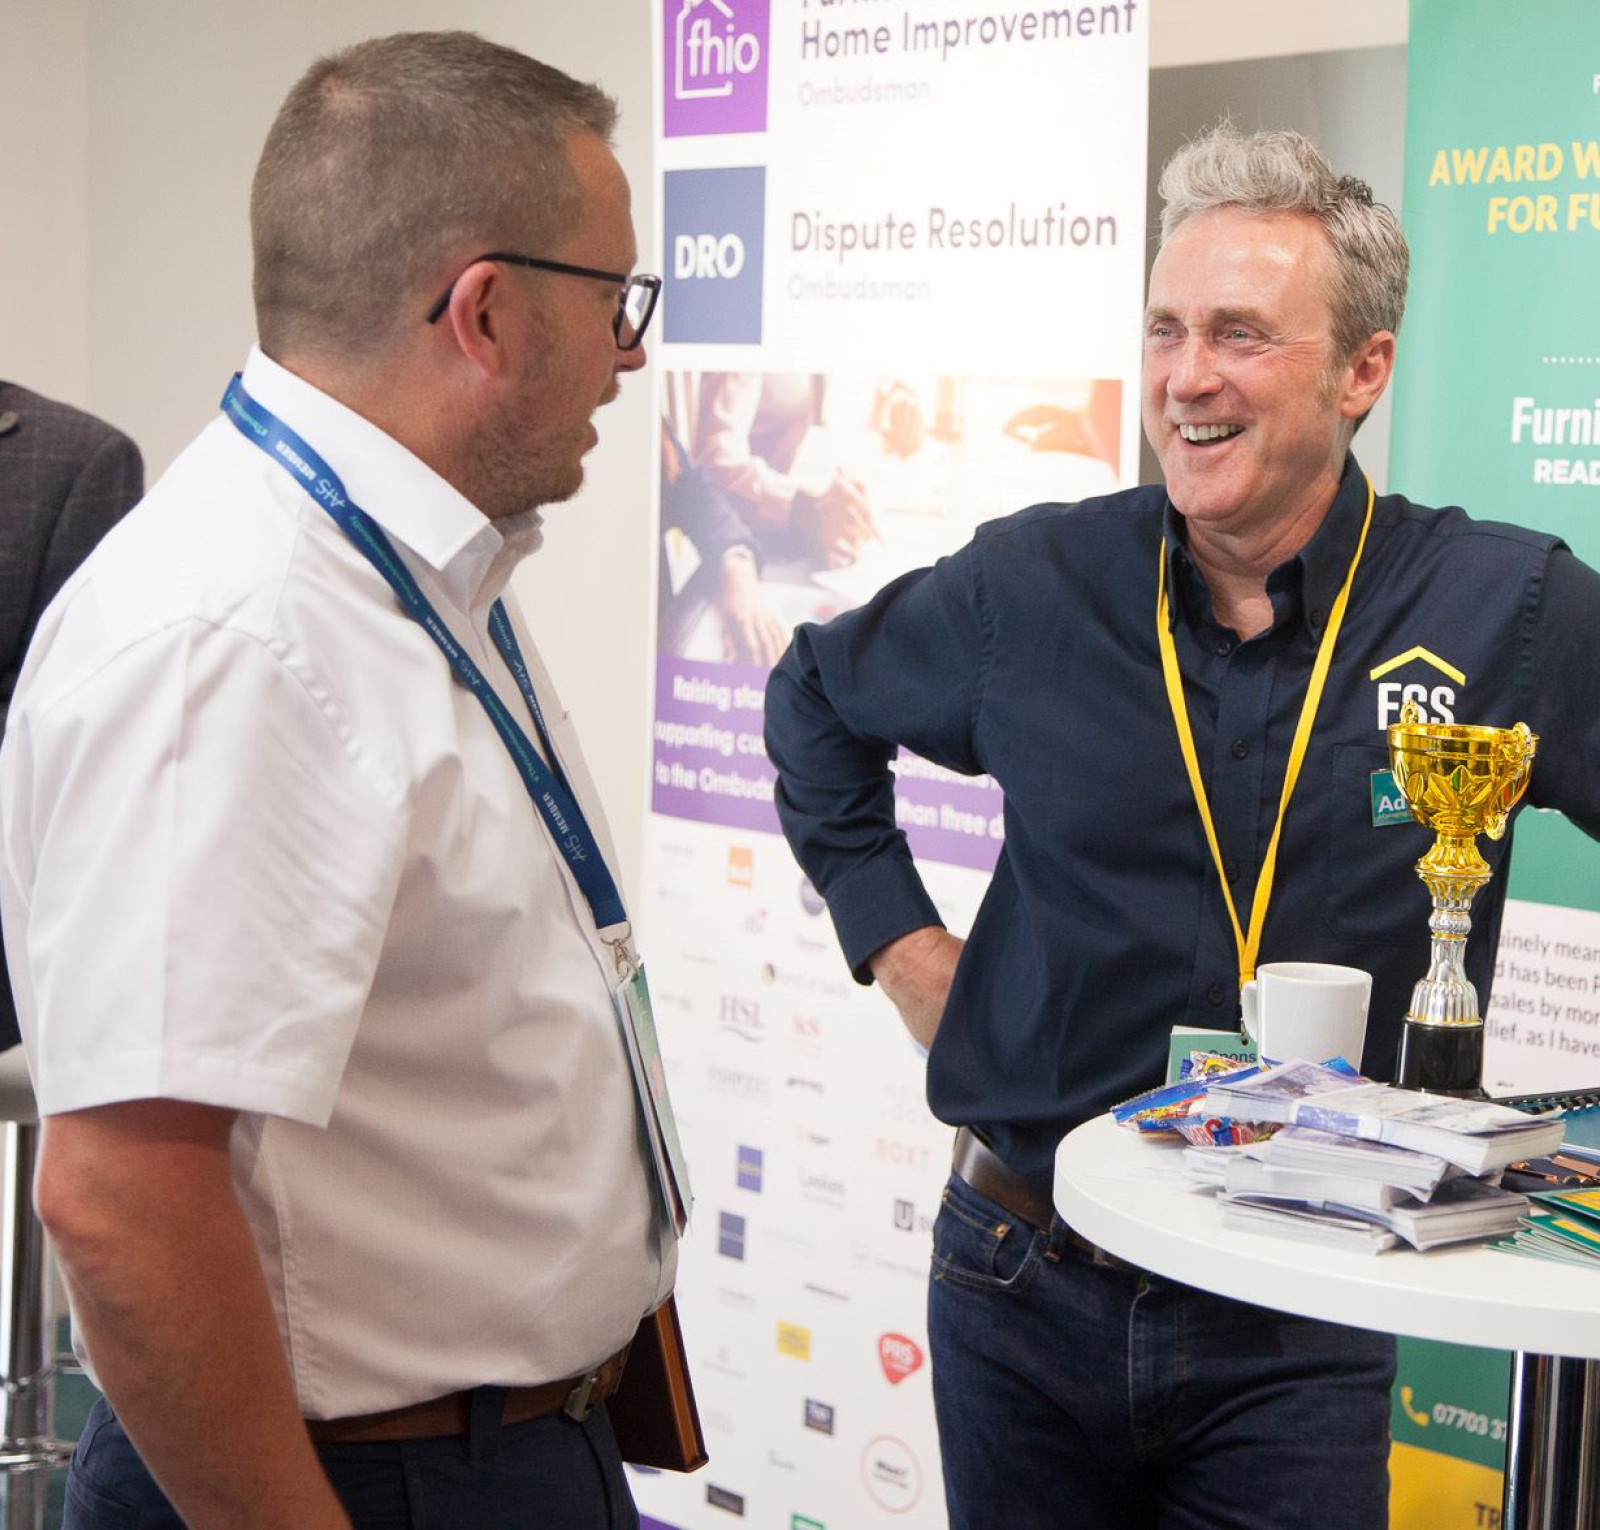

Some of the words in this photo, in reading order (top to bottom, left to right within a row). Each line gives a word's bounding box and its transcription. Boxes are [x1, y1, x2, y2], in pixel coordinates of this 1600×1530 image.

[686, 17, 760, 77] fhio
[801, 19, 891, 59] Home
[903, 0, 1137, 61] Improvement
[797, 78, 931, 105] Ombudsman
[1428, 142, 1563, 188] AWARD
[791, 211, 917, 264] Dispute
[928, 202, 1117, 249] Resolution
[1486, 194, 1558, 235] FOR
[673, 233, 745, 280] DRO
[787, 271, 931, 300] Ombudsman
[1511, 396, 1600, 446] Furni
[275, 439, 318, 481] MEMBER
[426, 614, 459, 659] MEMBER
[673, 675, 731, 712] Raising
[542, 791, 568, 835] MEMBER
[1510, 961, 1541, 984] has
[1544, 966, 1588, 993] been
[1491, 992, 1535, 1015] sales
[1540, 995, 1563, 1021] by
[1525, 1030, 1545, 1047] as
[1549, 1030, 1555, 1049] I
[1560, 1031, 1600, 1058] have
